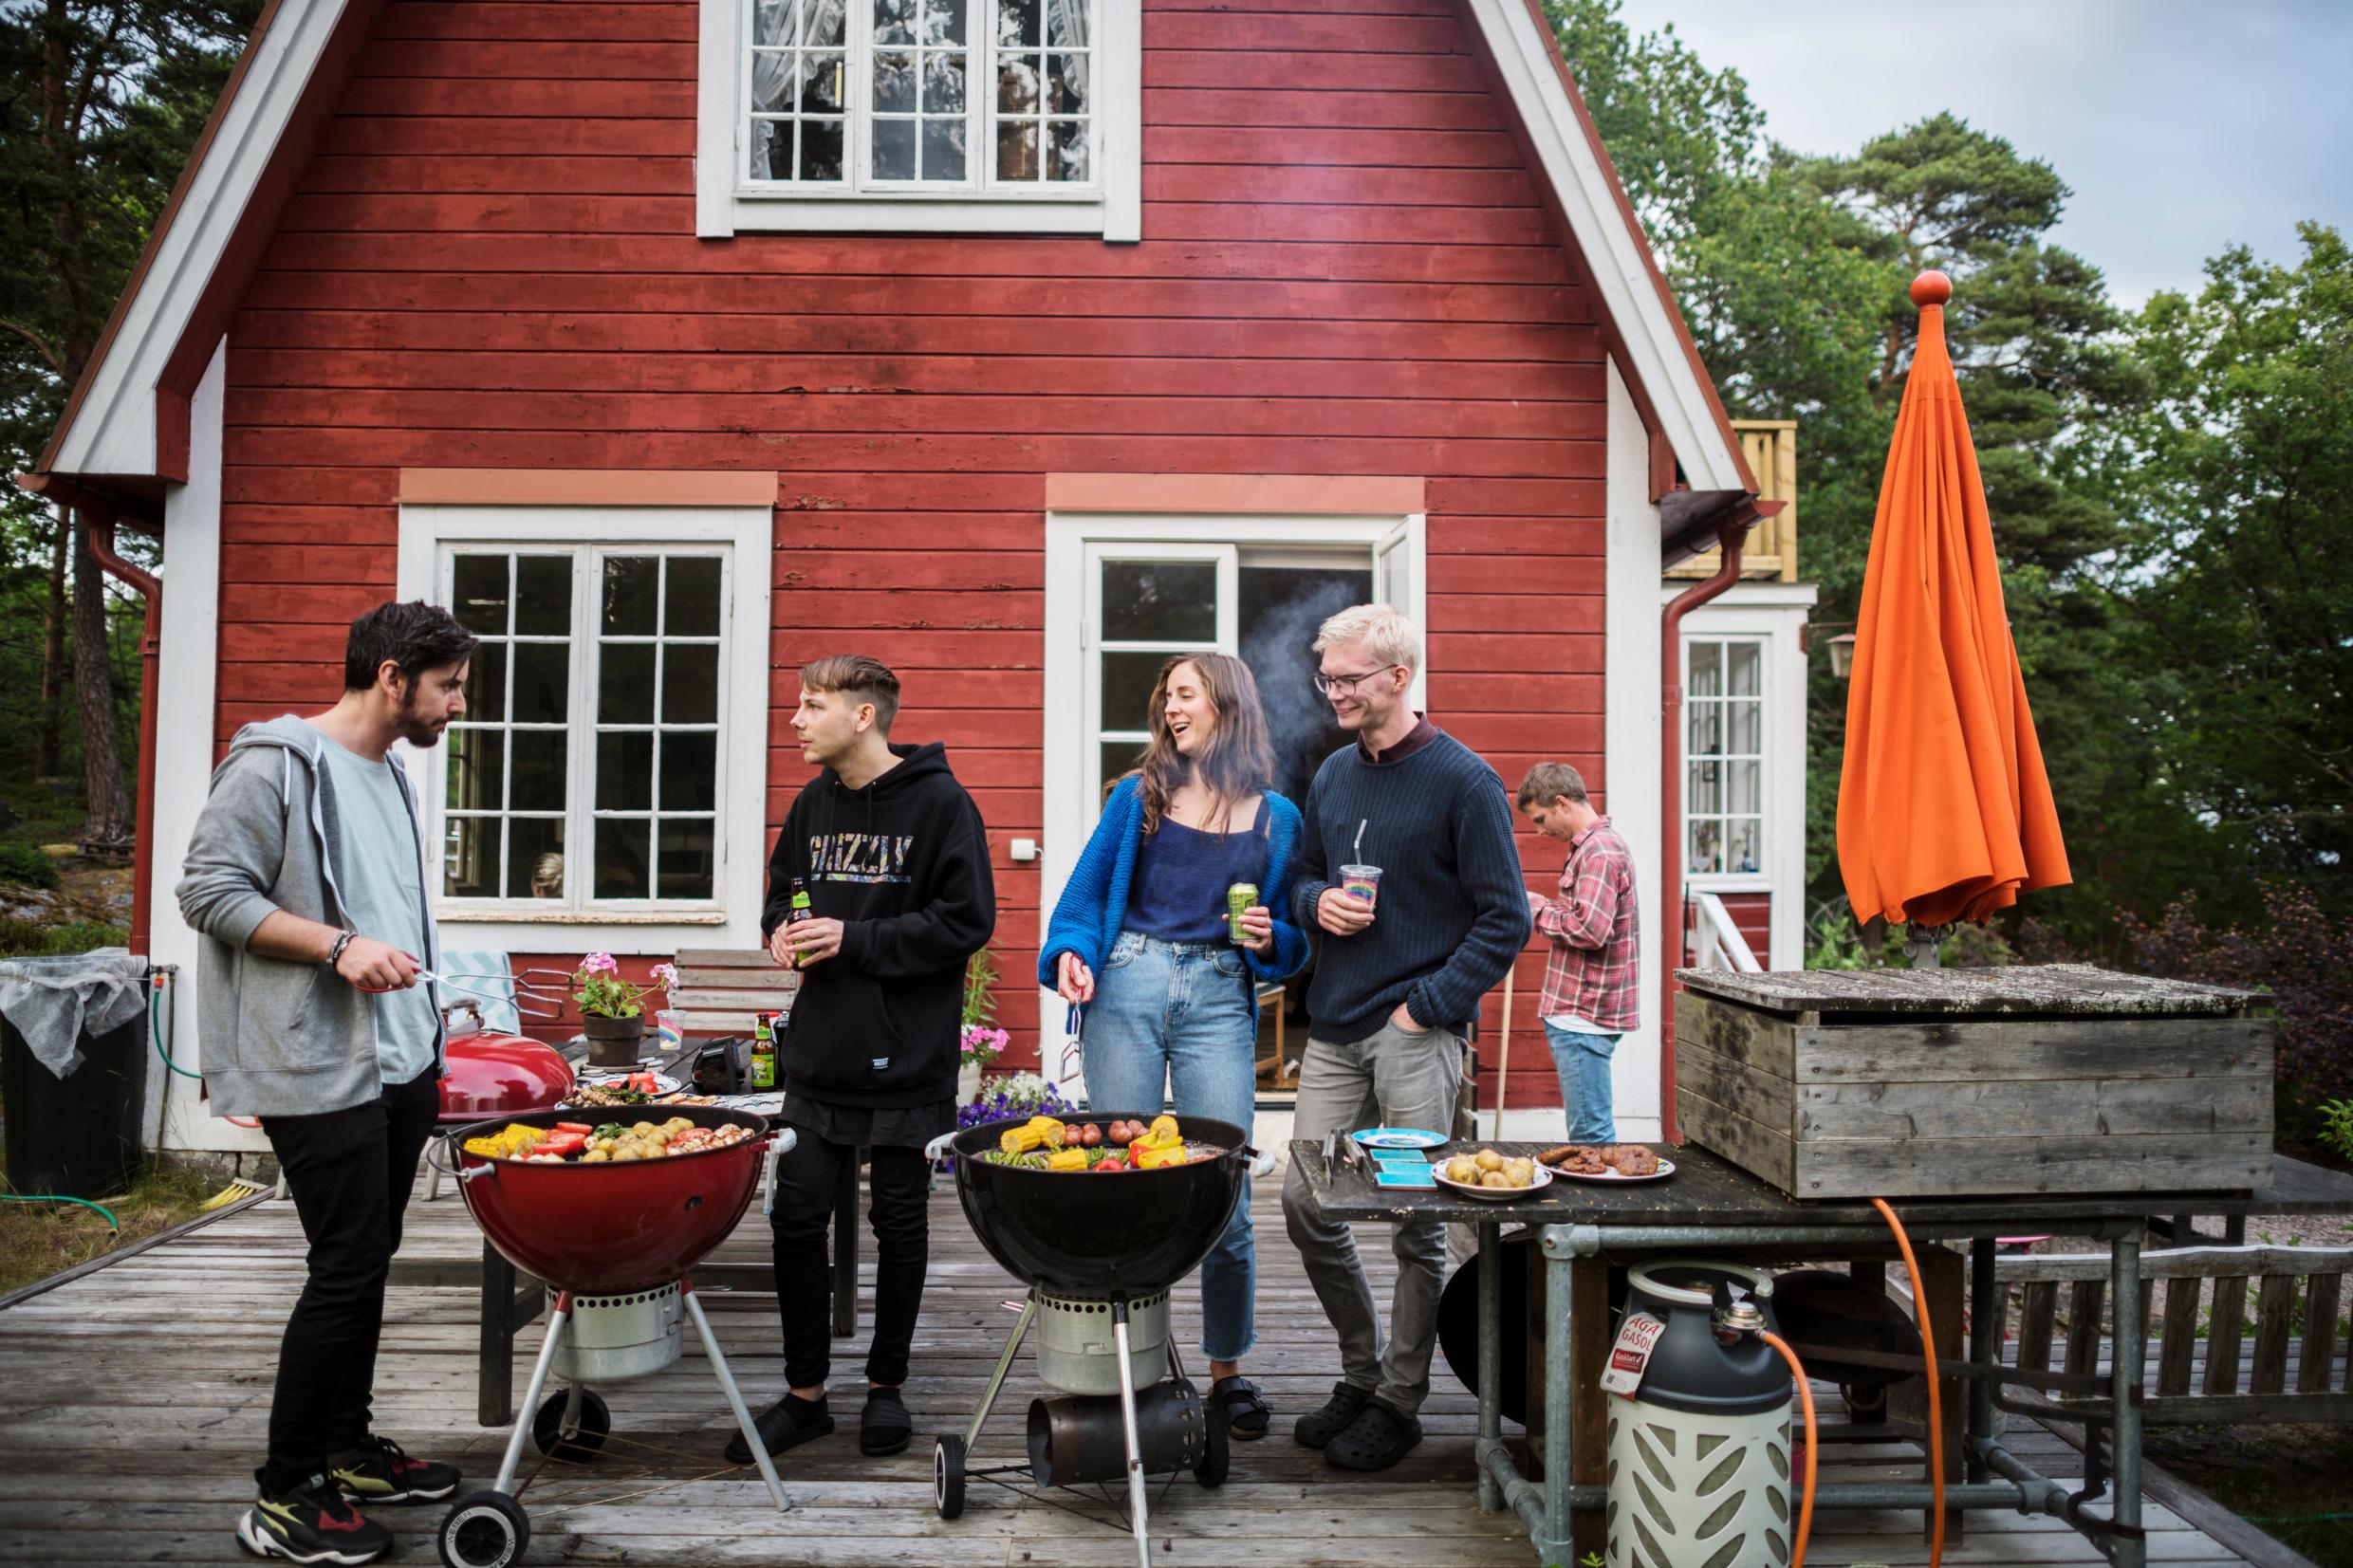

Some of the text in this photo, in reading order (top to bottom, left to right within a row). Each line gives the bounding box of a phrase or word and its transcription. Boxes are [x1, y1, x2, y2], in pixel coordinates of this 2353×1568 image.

[810, 833, 914, 873] GRIZZLY
[1621, 1328, 1652, 1351] GASOL
[1629, 1317, 1660, 1336] AGA
[448, 1511, 472, 1544] WEBER
[490, 1538, 515, 1568] WEB
